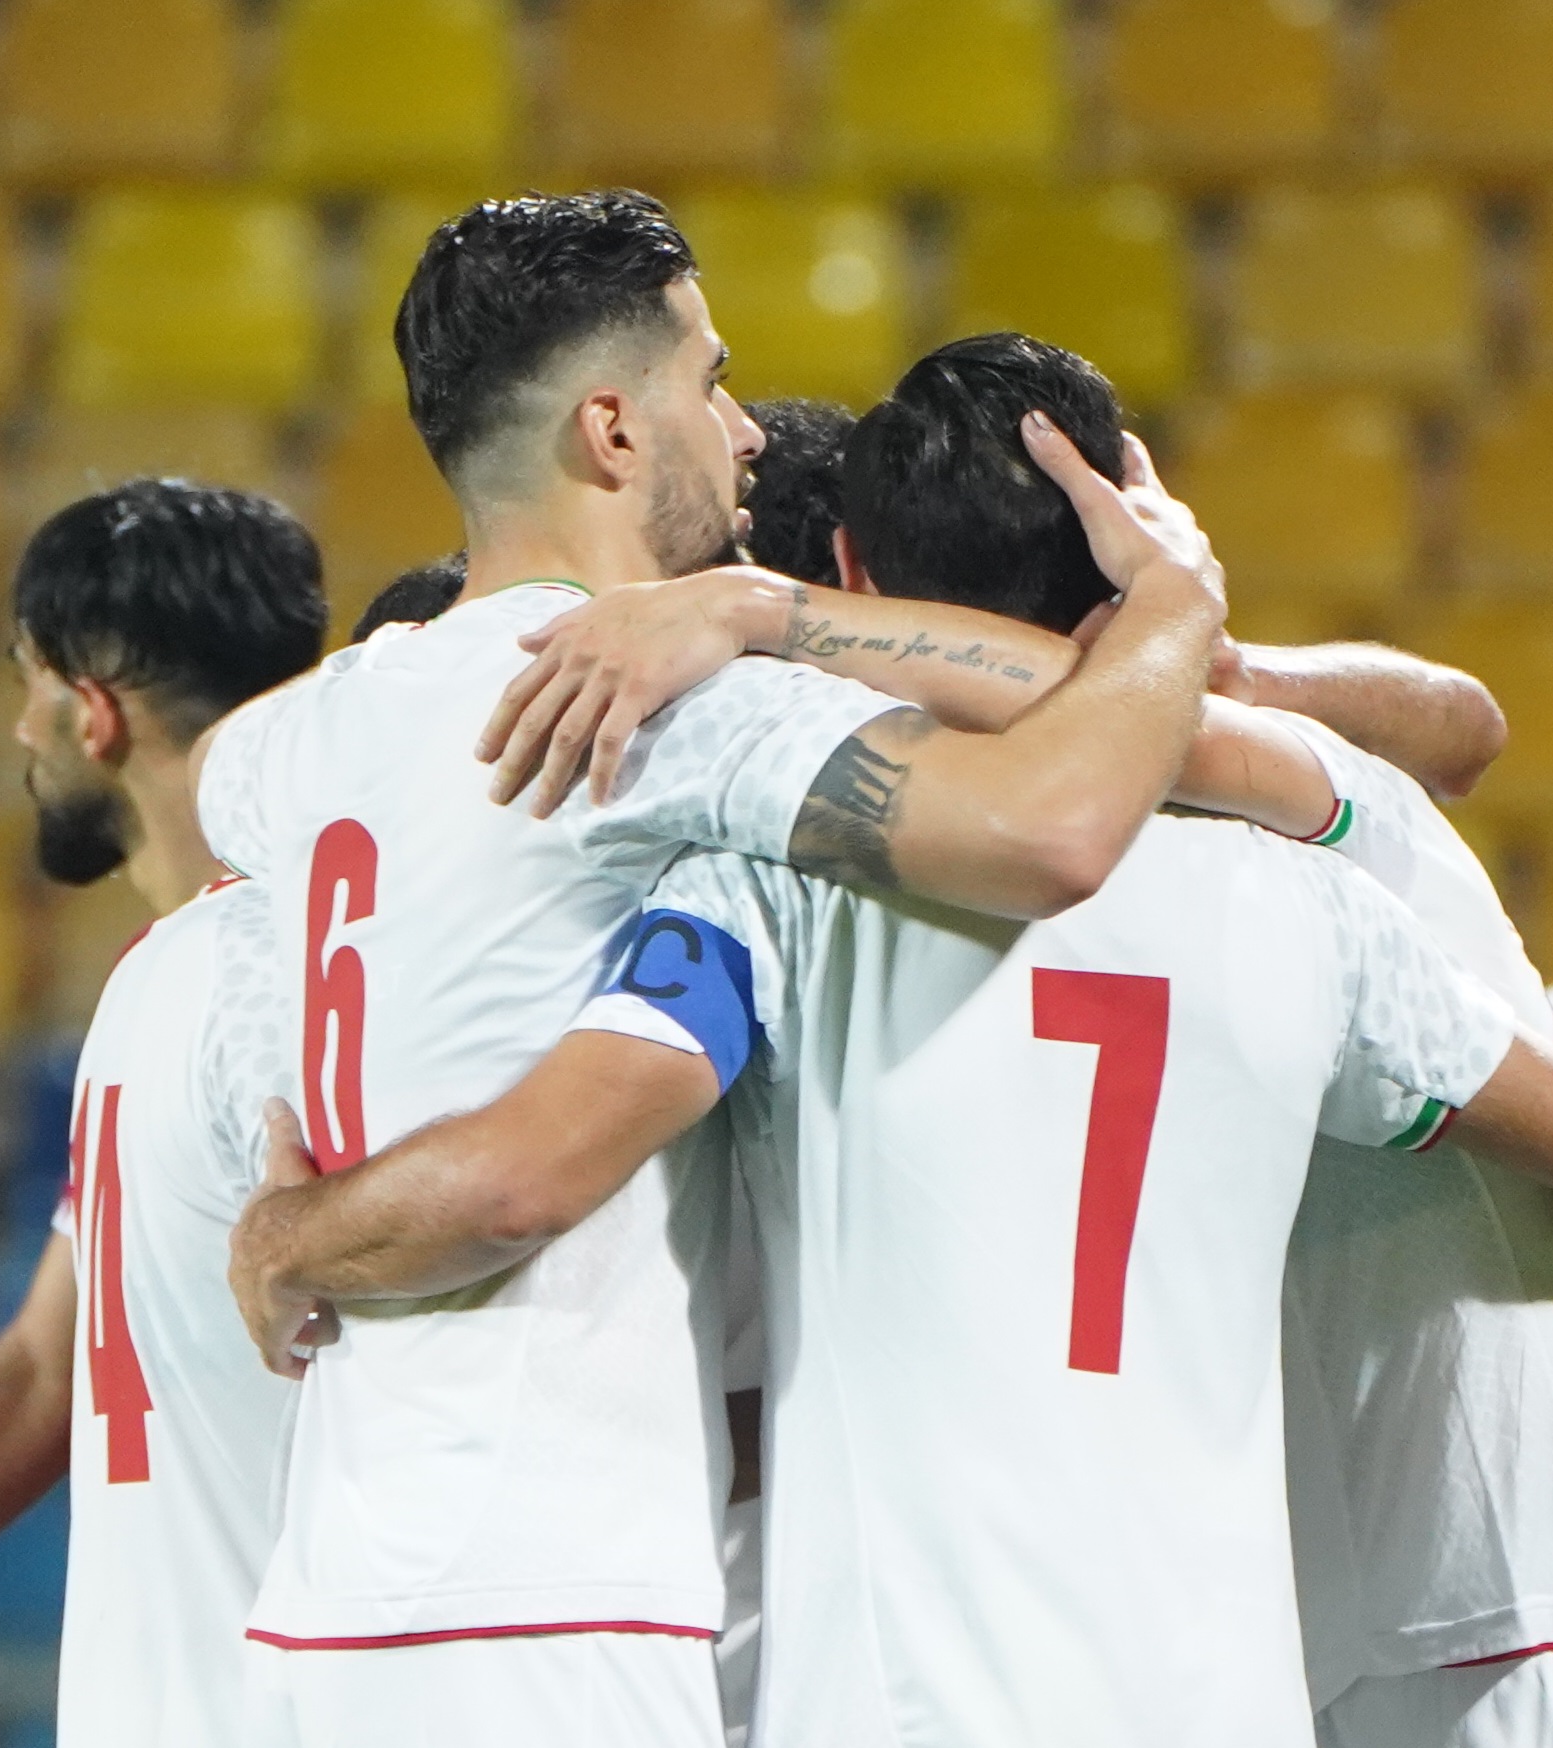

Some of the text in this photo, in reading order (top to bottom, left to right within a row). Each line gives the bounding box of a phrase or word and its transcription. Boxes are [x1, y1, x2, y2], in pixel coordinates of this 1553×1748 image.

[797, 619, 859, 656] Love
[861, 637, 897, 652] me
[891, 631, 939, 662] for
[303, 818, 378, 1174] 6
[619, 916, 703, 1000] C
[1031, 966, 1170, 1375] 7
